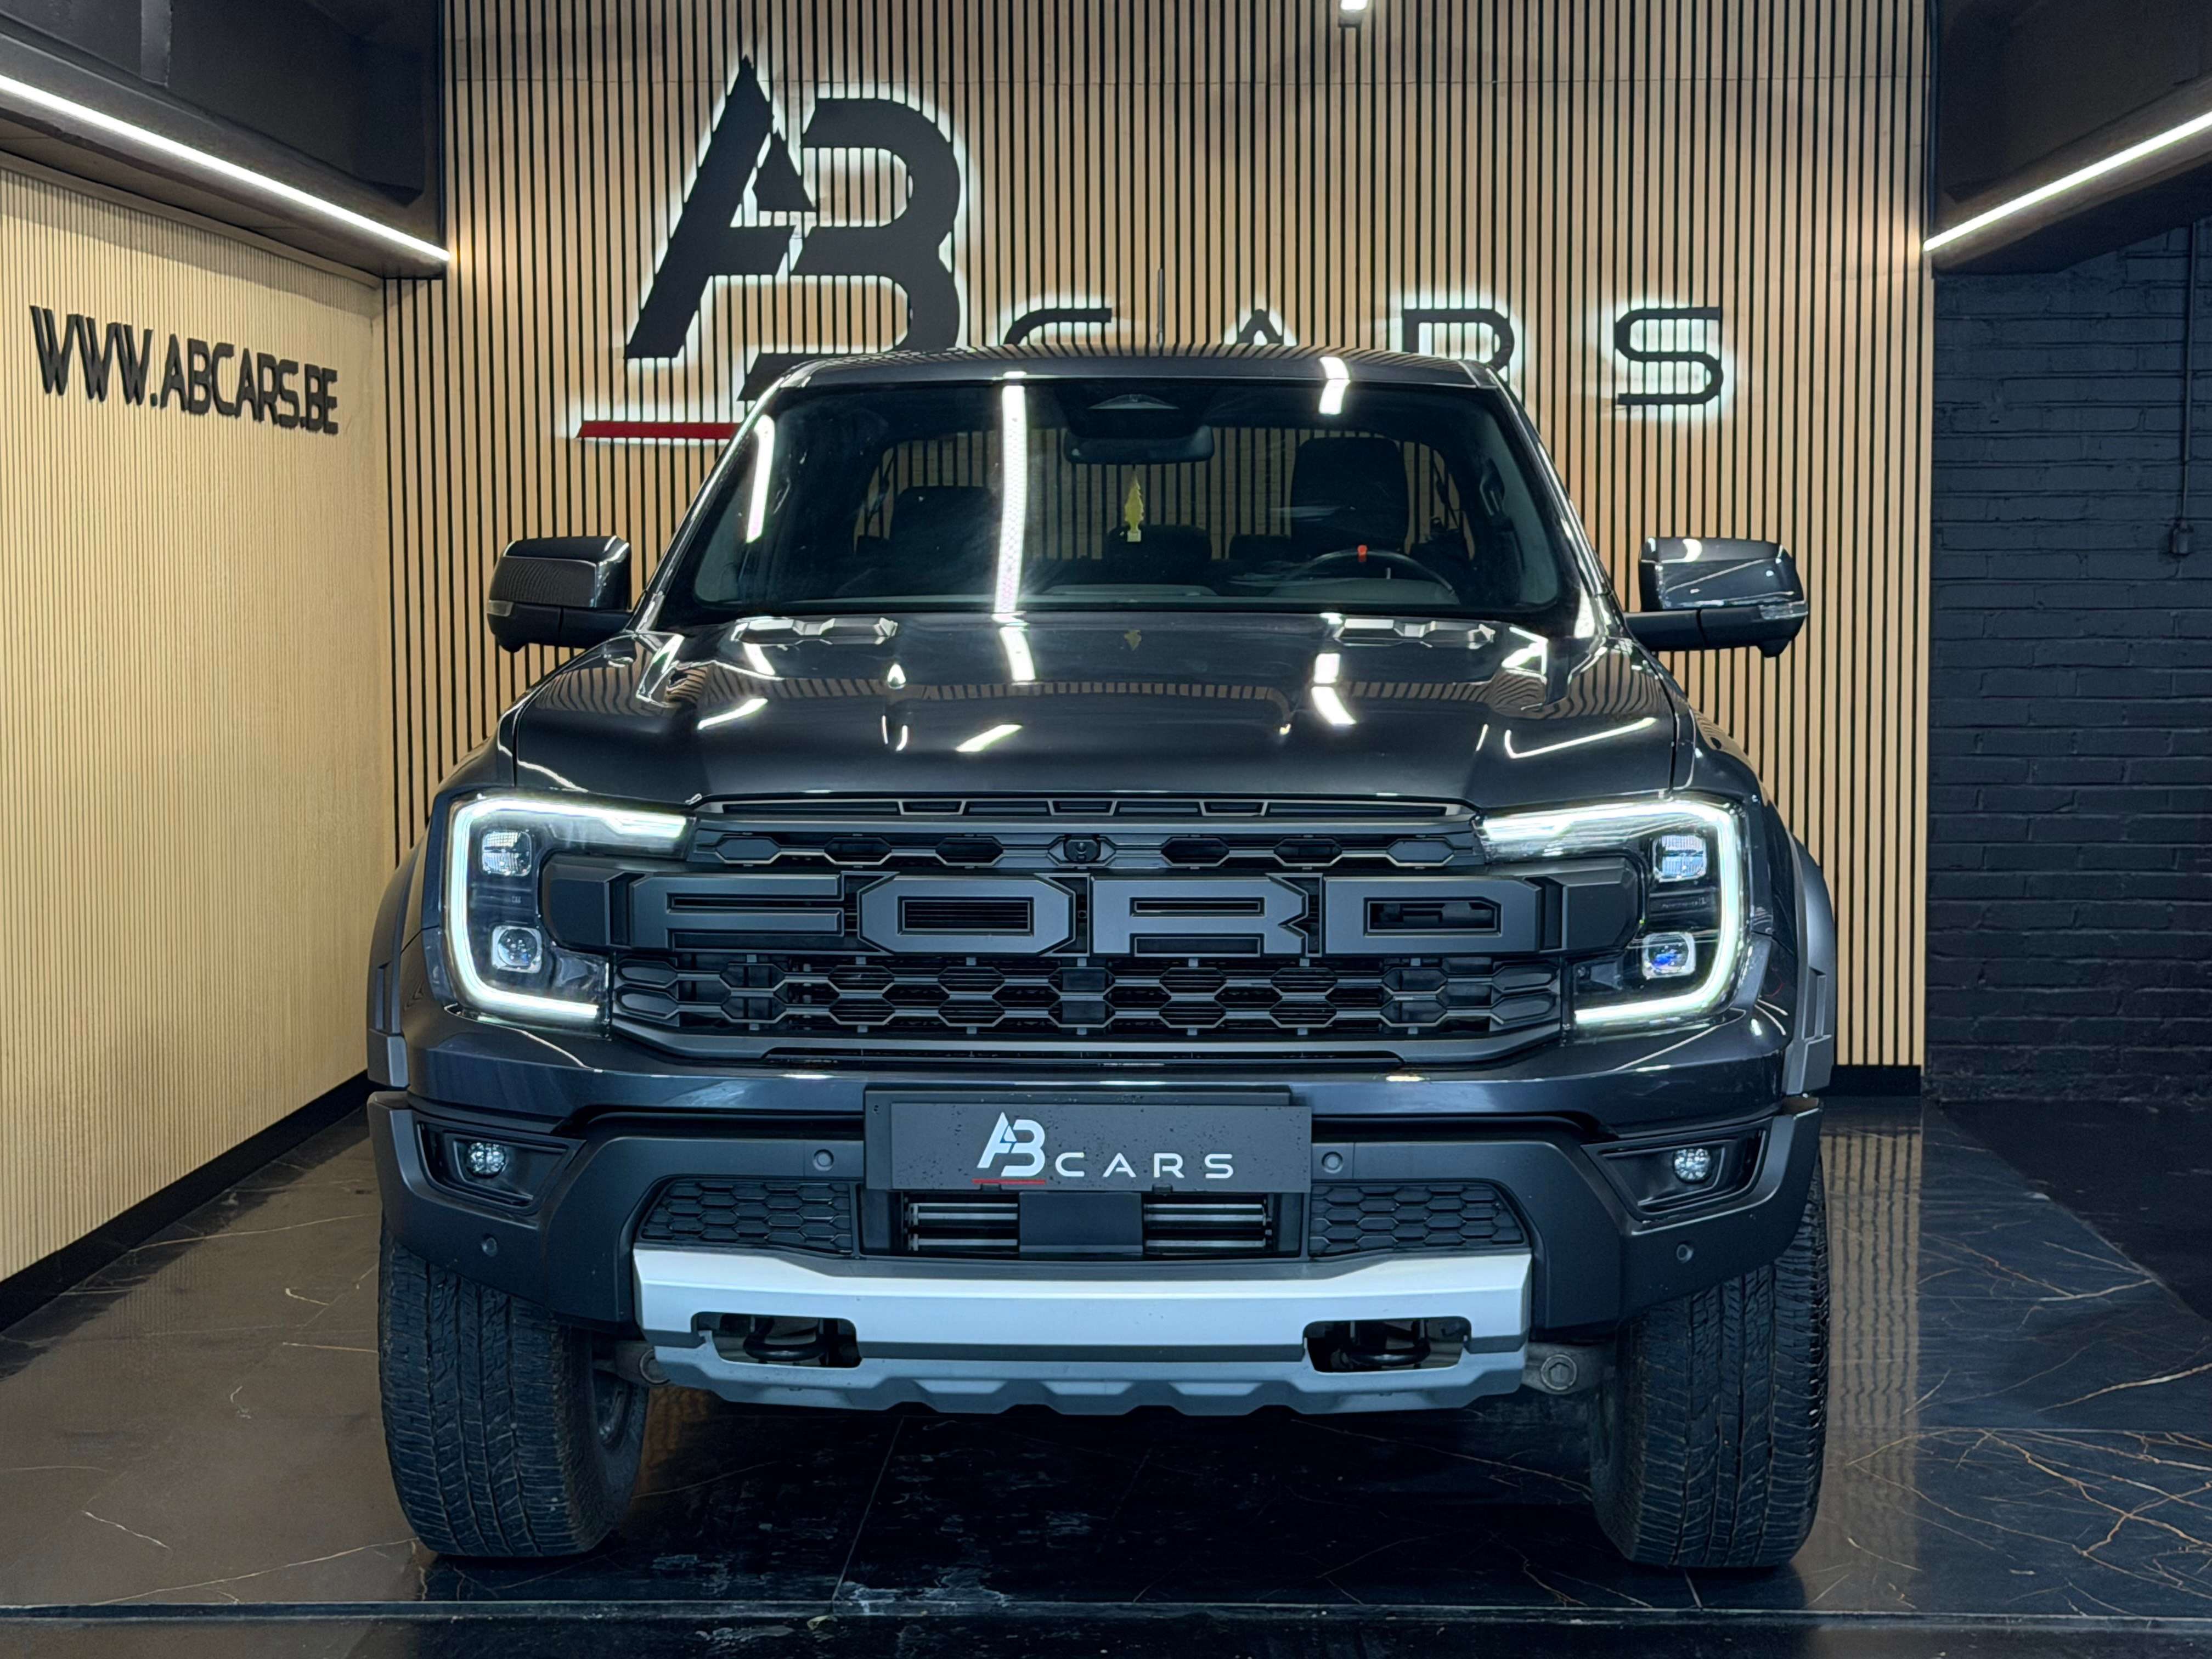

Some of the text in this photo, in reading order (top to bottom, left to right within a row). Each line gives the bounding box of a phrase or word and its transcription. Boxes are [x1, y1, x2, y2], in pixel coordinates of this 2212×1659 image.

[624, 55, 961, 402] AB
[30, 305, 338, 435] WWW.ABCARS.BE
[633, 874, 1540, 957] FORD
[978, 1112, 1233, 1178] AB CARS
